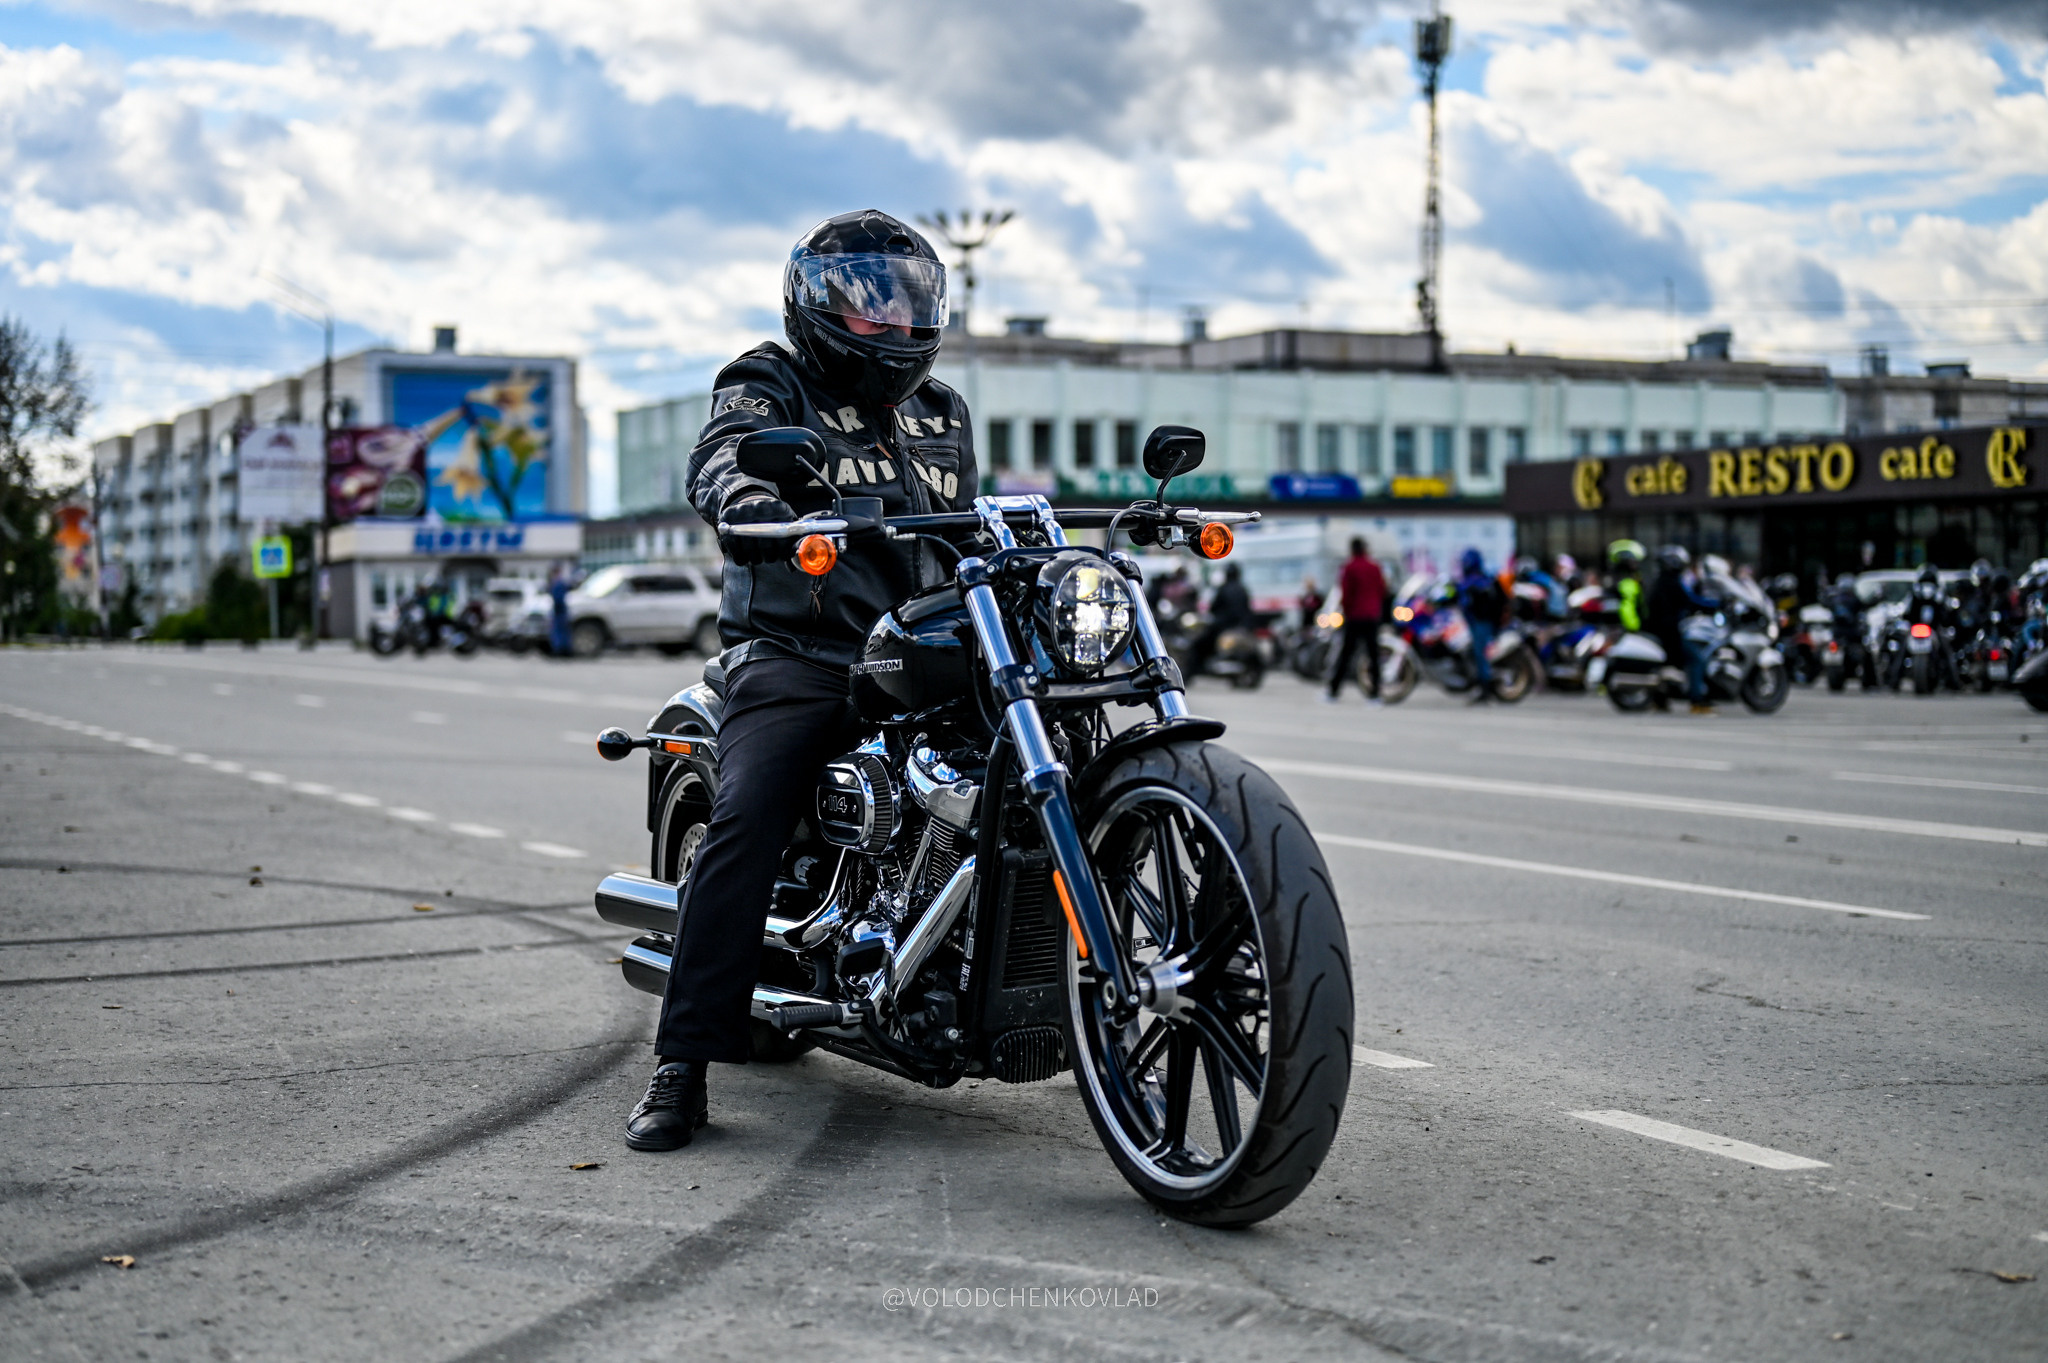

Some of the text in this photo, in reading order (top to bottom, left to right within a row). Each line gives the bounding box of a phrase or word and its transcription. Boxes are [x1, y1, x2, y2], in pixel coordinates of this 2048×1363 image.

[1625, 457, 1687, 496] cafe
[1708, 442, 1855, 498] RESTO
[1880, 436, 1955, 481] cafe
[828, 795, 848, 813] 114
